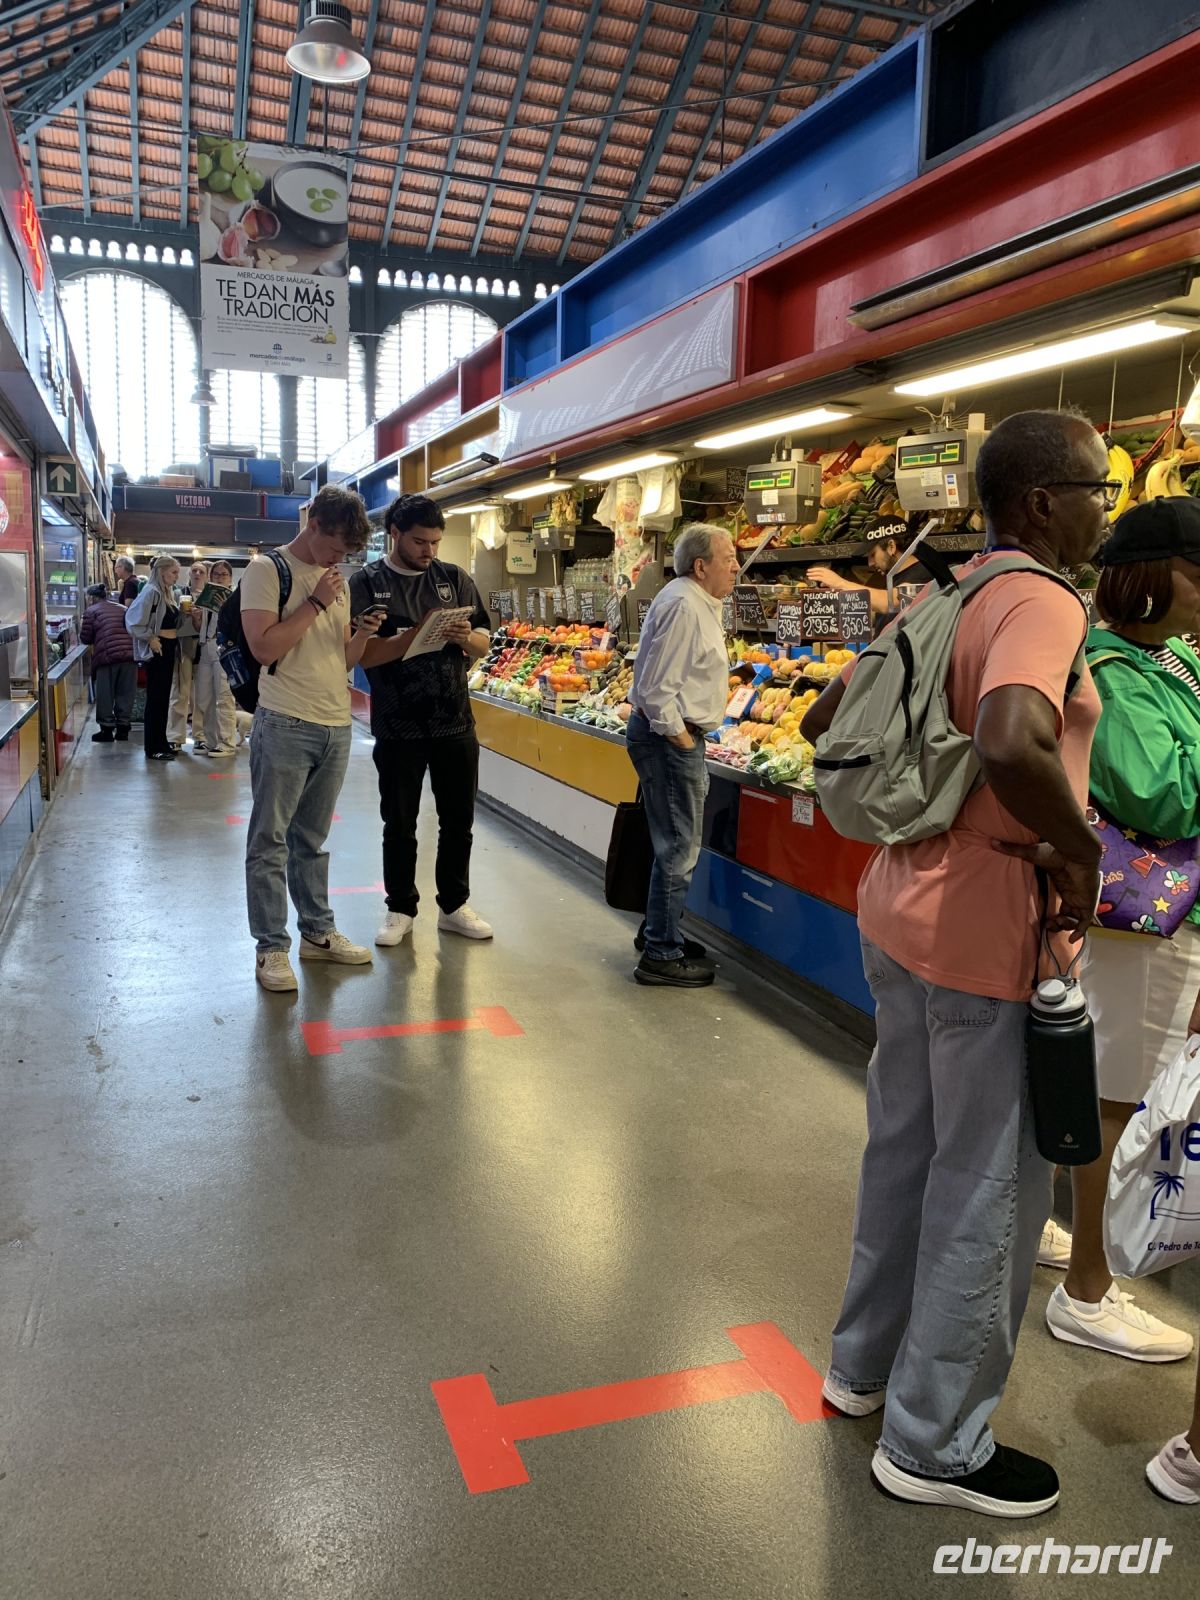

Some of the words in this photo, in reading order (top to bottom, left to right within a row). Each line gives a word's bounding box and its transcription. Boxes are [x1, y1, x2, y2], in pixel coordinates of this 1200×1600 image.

[237, 271, 275, 282] MERCADOS
[286, 276, 315, 285] MÁLAGA
[216, 278, 237, 297] TE
[243, 281, 288, 302] DAN
[294, 283, 335, 307] MÁS
[222, 297, 328, 325] TRADICIÓN
[175, 494, 211, 507] VICTORIA
[866, 523, 907, 540] adidas
[1158, 1241, 1181, 1251] Pedro
[1182, 1241, 1193, 1250] de
